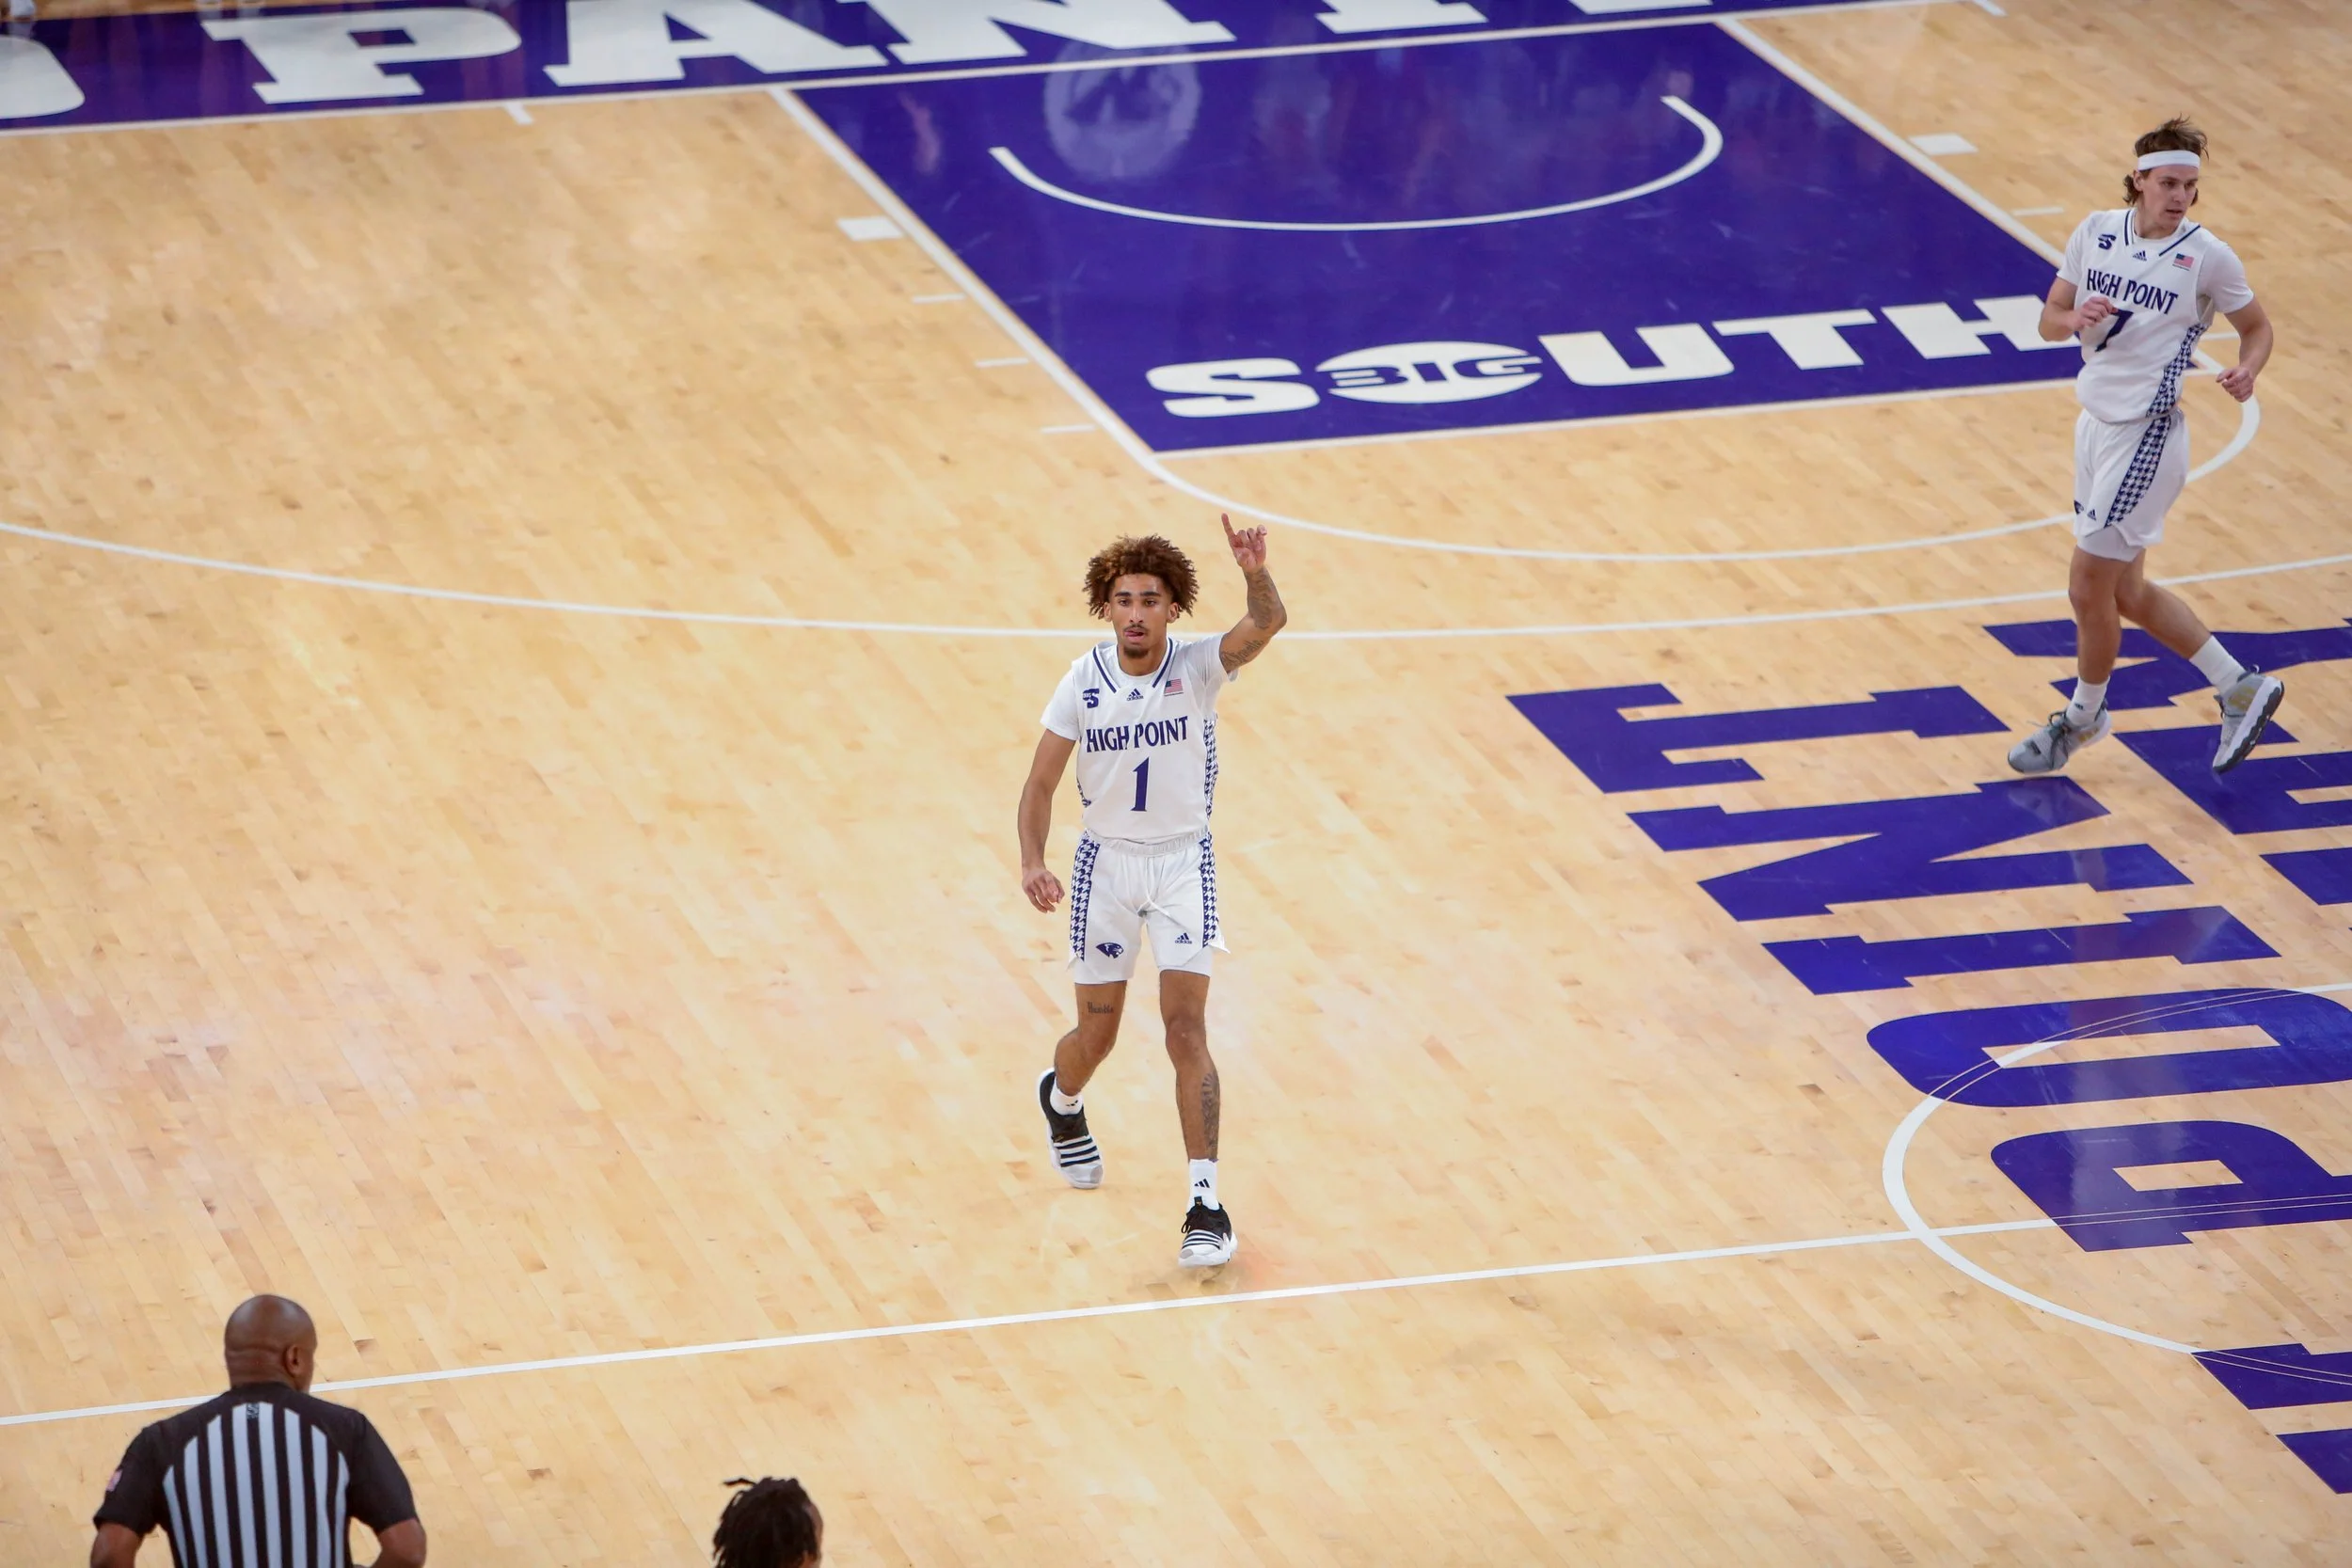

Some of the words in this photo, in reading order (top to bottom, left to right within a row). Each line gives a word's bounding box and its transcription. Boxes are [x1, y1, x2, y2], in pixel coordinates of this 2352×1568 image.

[2087, 268, 2122, 298] HIGH
[2122, 279, 2179, 315] POINT
[2095, 308, 2134, 353] 7
[1086, 725, 1130, 752] HIGH
[1134, 716, 1188, 750] POINT
[1131, 757, 1150, 812] 1
